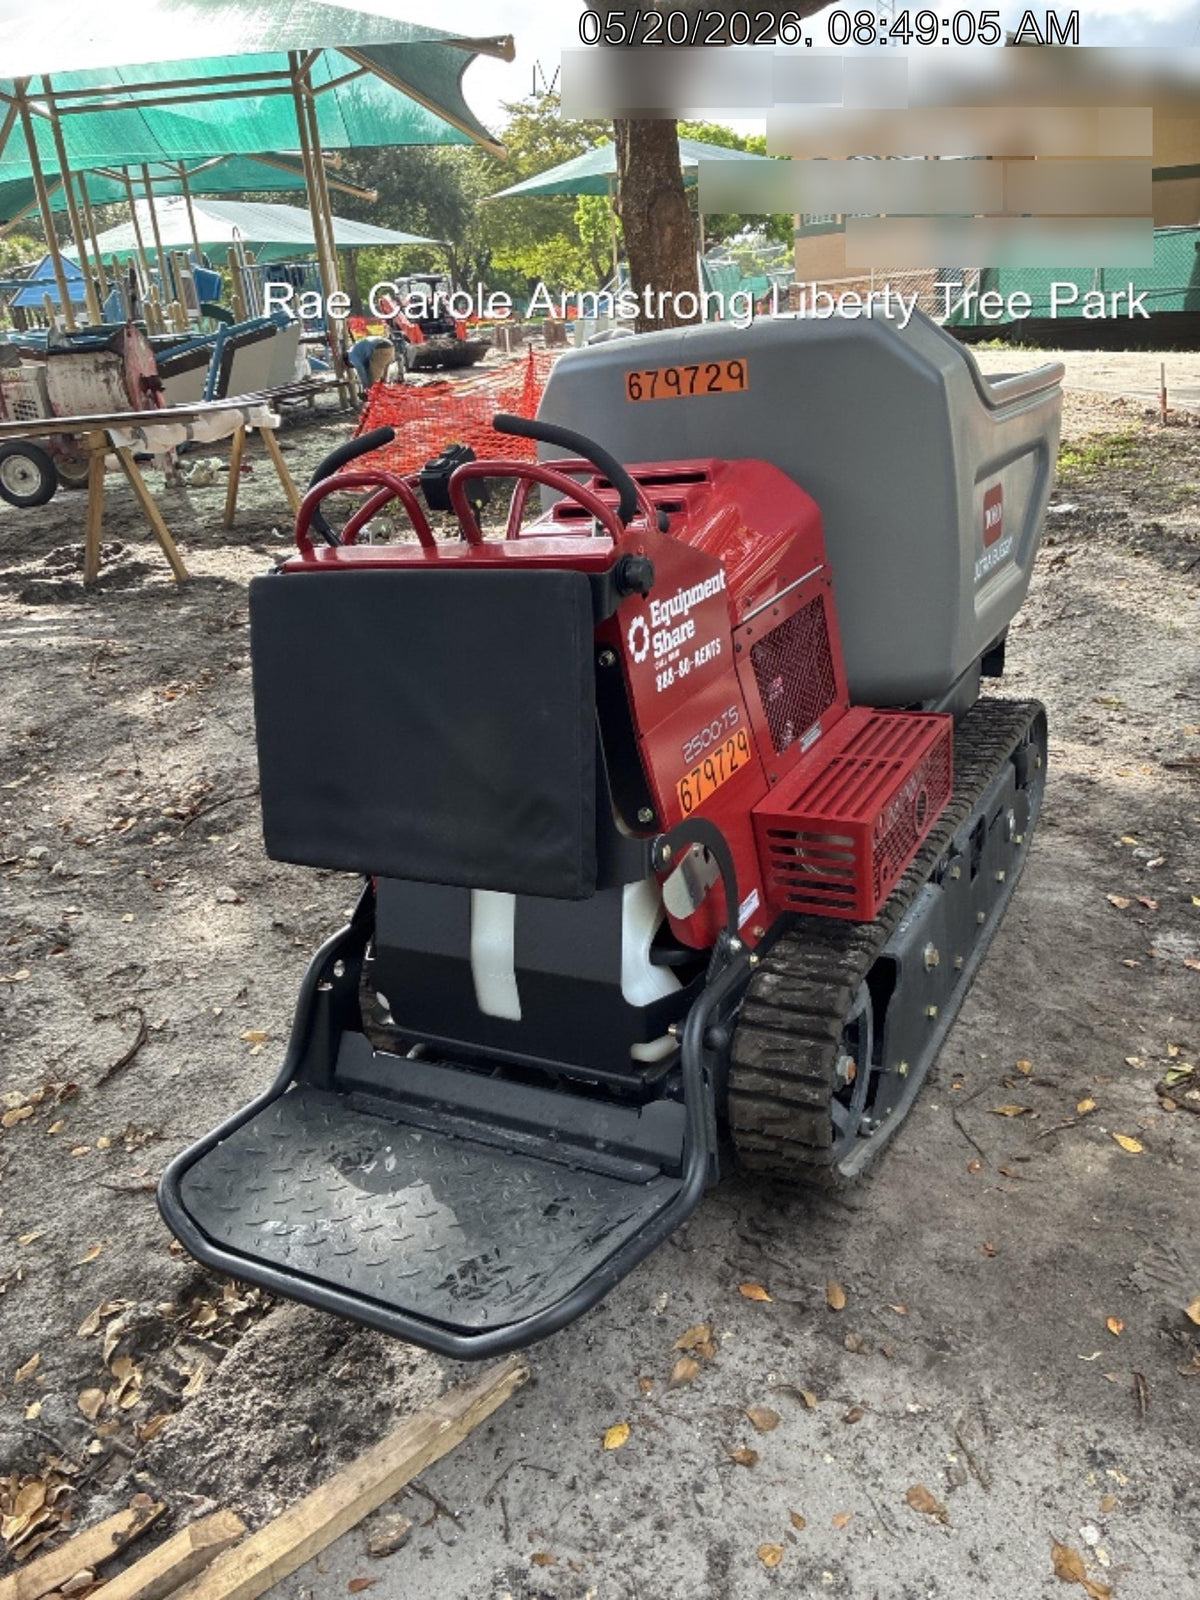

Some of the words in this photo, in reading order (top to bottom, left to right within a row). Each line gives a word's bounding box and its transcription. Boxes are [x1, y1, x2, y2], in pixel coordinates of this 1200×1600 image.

[628, 360, 744, 400] 679729
[649, 567, 726, 628] Equipment
[652, 618, 696, 659] Share
[679, 729, 750, 813] 679729
